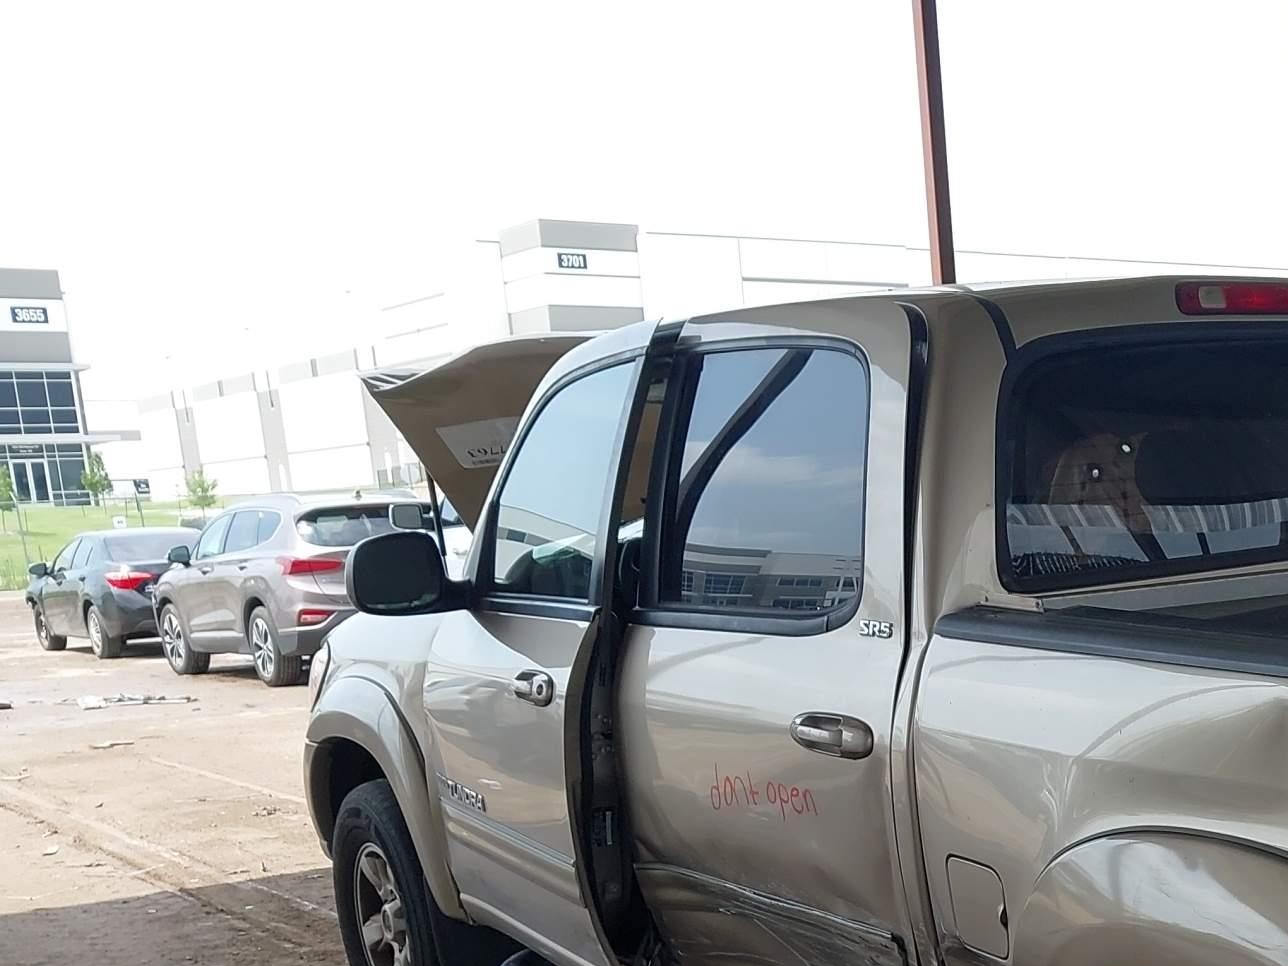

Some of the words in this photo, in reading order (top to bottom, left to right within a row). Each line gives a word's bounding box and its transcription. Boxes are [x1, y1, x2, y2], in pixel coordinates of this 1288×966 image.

[560, 254, 585, 268] 3701
[14, 308, 45, 322] 3655
[859, 620, 893, 638] SR5
[711, 762, 759, 810] dont
[766, 781, 818, 822] open
